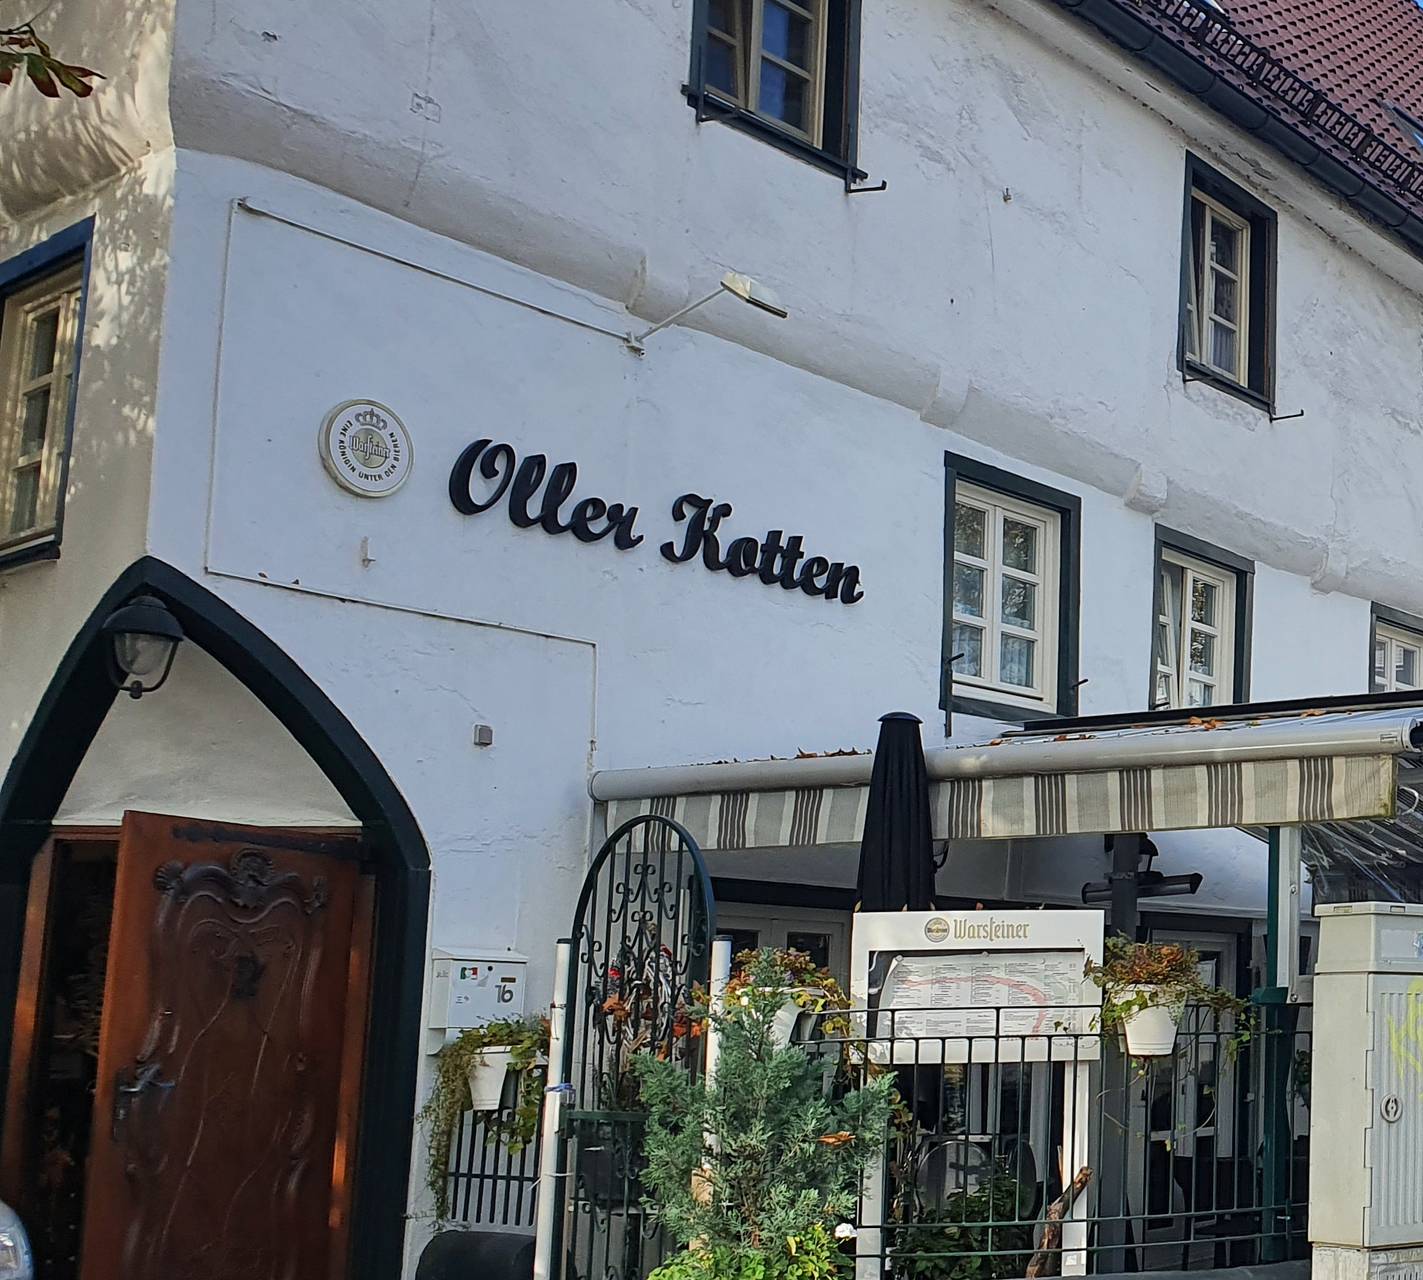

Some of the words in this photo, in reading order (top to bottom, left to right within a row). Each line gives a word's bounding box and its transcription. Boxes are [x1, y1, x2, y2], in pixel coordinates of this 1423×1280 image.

[340, 420, 353, 438] EINE
[388, 432, 400, 462] BIEREN
[358, 471, 384, 482] UNTER
[384, 463, 398, 478] DEN
[448, 438, 645, 551] Oller
[660, 493, 864, 605] Kotten
[953, 916, 1030, 942] Warsteiner
[495, 984, 514, 1004] 16
